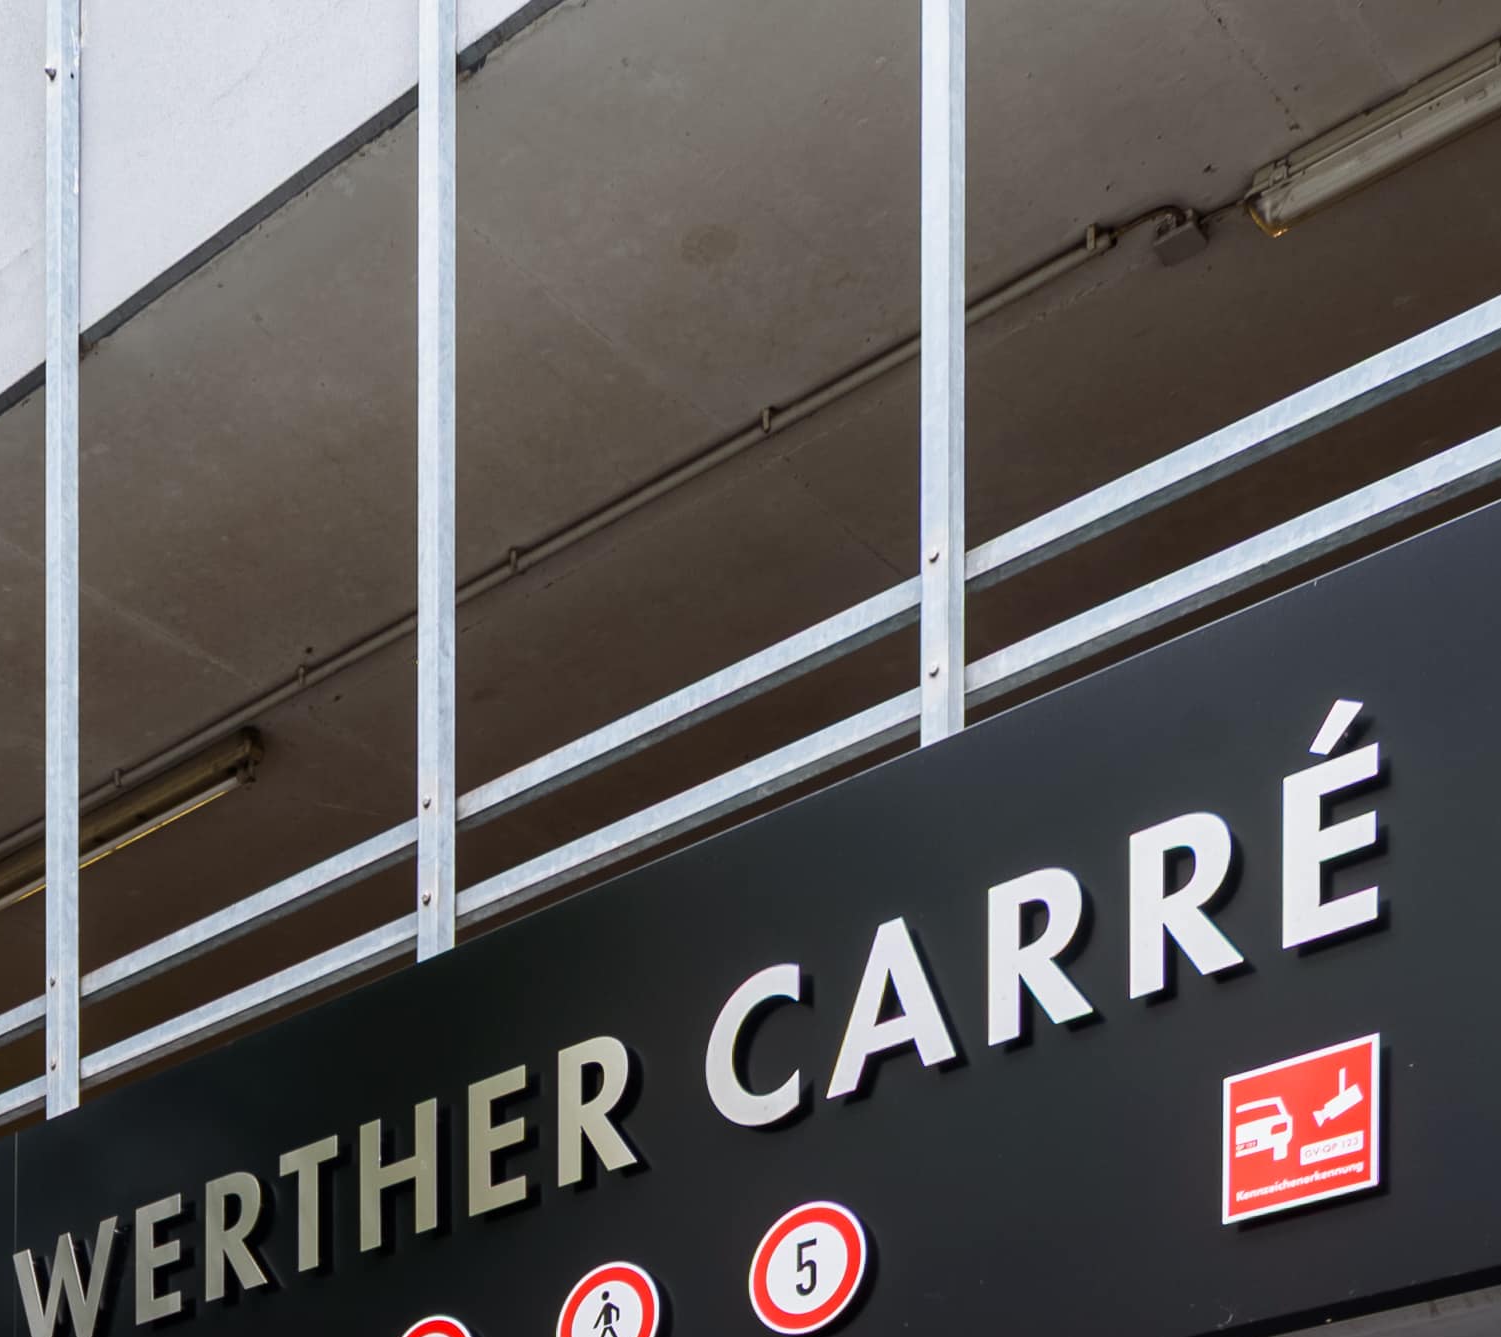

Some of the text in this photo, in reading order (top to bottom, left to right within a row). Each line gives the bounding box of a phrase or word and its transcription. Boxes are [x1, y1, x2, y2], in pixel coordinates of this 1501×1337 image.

[705, 698, 1379, 1127] CARRÉ
[1236, 1162, 1364, 1202] Kennzeichenerkennung
[796, 1238, 817, 1297] 5
